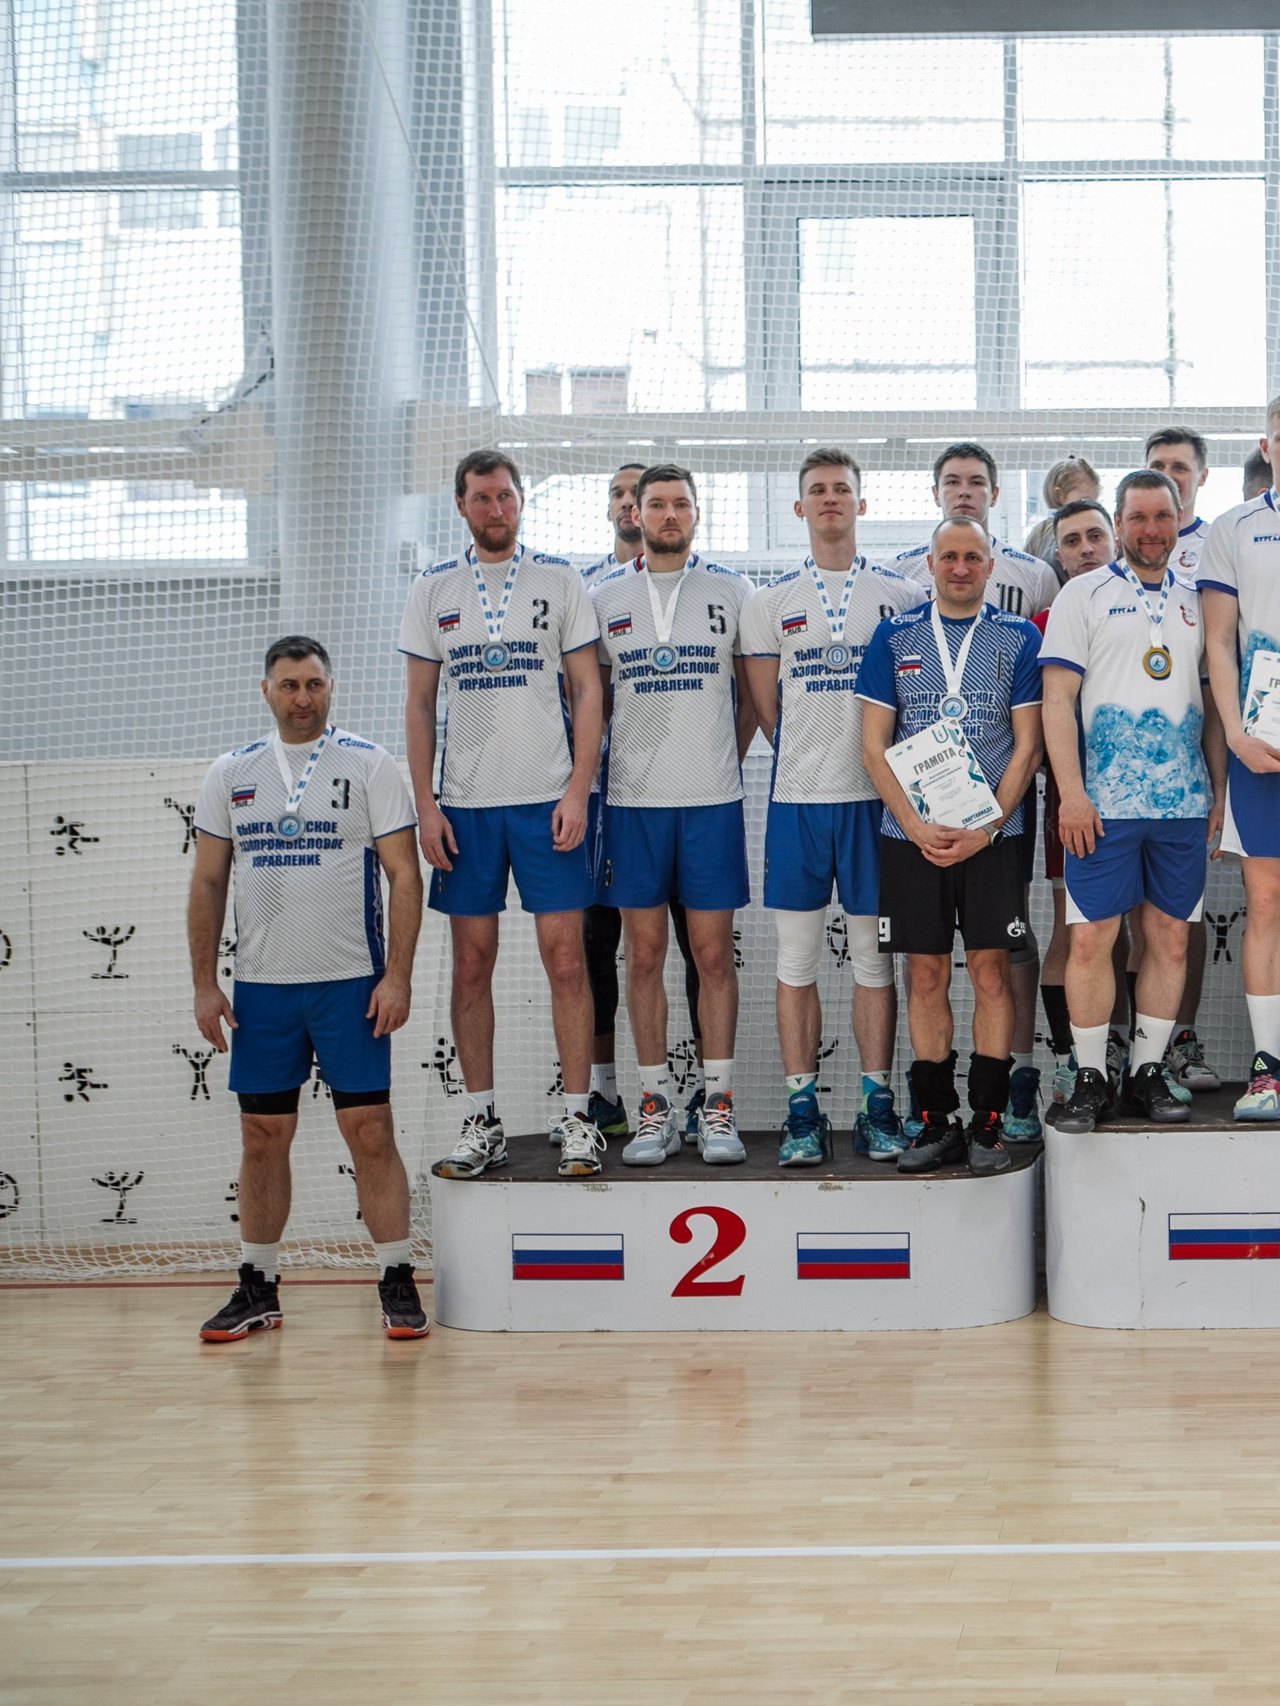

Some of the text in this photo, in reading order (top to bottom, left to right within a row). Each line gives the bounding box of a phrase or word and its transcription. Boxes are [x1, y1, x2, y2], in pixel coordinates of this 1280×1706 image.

[996, 583, 1023, 617] 10
[532, 599, 549, 630] 2
[707, 604, 727, 634] 5
[613, 629, 627, 637] RUS
[787, 627, 802, 635] RUS
[618, 646, 716, 664] ВЫНГНСКОЕ
[458, 674, 528, 691] УПРАВЛЕНИЕ
[633, 678, 703, 694] УПРАВЛЕНИЕ
[806, 679, 857, 692] УПРАВЛЕ
[913, 747, 957, 775] ГРАМОТА
[331, 778, 351, 809] 3
[236, 821, 338, 836] ВЫНГАСКОЕ
[878, 917, 892, 943] 9
[668, 1205, 748, 1298] 2
